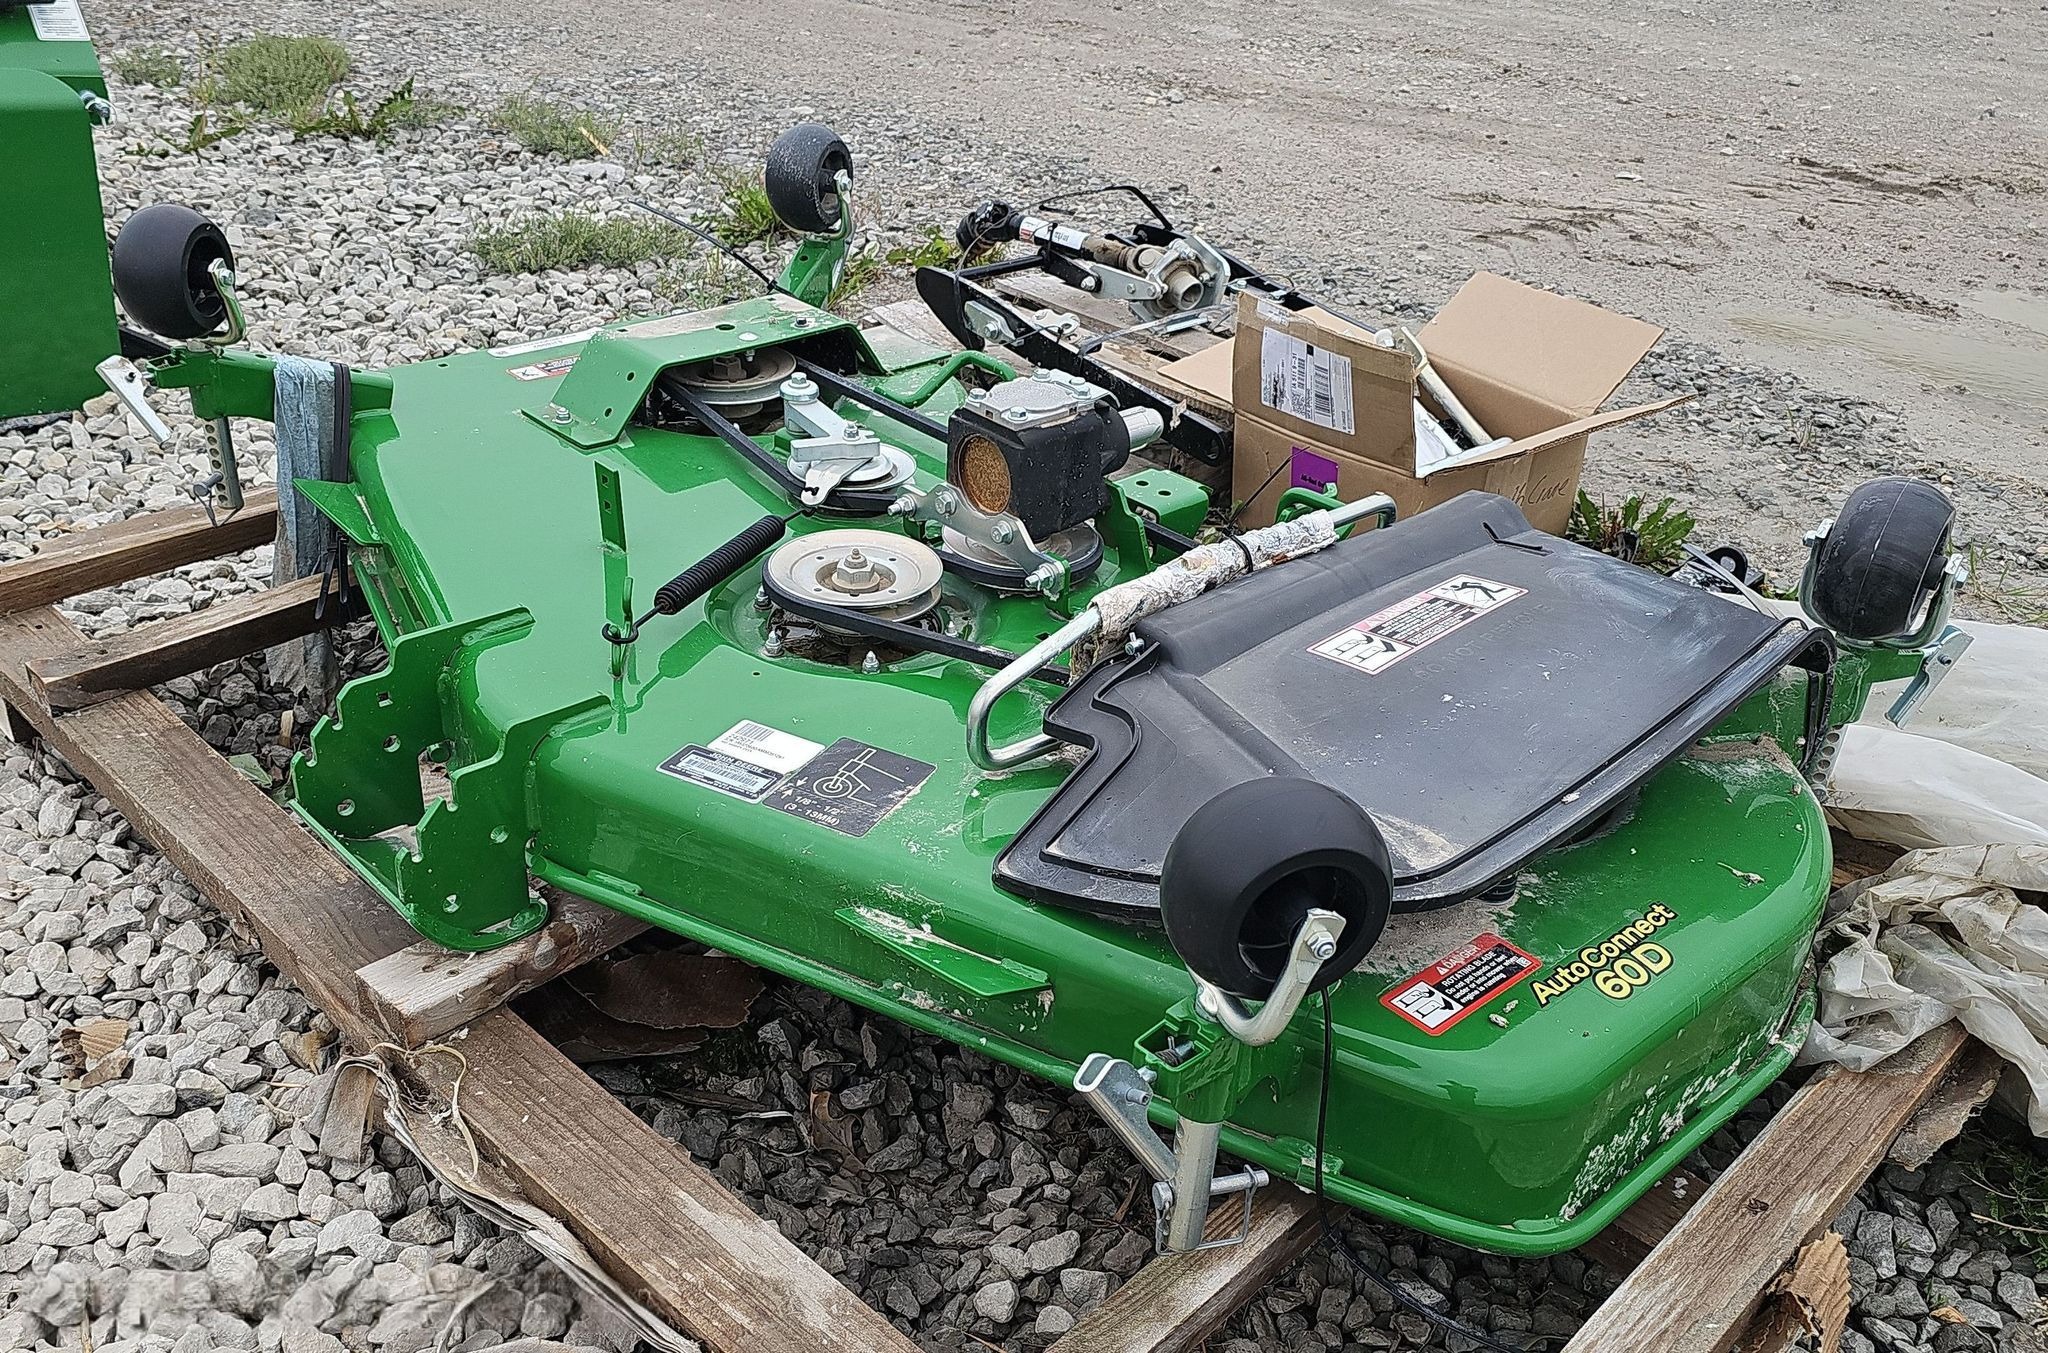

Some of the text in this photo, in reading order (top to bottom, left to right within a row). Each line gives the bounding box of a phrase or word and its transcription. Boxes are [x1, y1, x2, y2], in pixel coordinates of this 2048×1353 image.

[709, 752, 735, 764] JOHN
[735, 759, 765, 773] DEERE
[784, 802, 797, 810] (3
[804, 809, 840, 825] 13MM)
[1441, 950, 1497, 988] ROTATING BLADE
[1531, 902, 1677, 1007] AutoConnect
[1594, 942, 1673, 999] 60D
[1445, 986, 1456, 995] Do
[1454, 980, 1466, 990] not
[1463, 974, 1475, 984] put
[1471, 963, 1491, 978] hands
[1495, 954, 1508, 963] feet
[1453, 985, 1470, 999] under
[1474, 974, 1487, 984] into
[1486, 964, 1504, 978] mower
[1460, 989, 1480, 1003] engine
[1484, 972, 1507, 988] running
